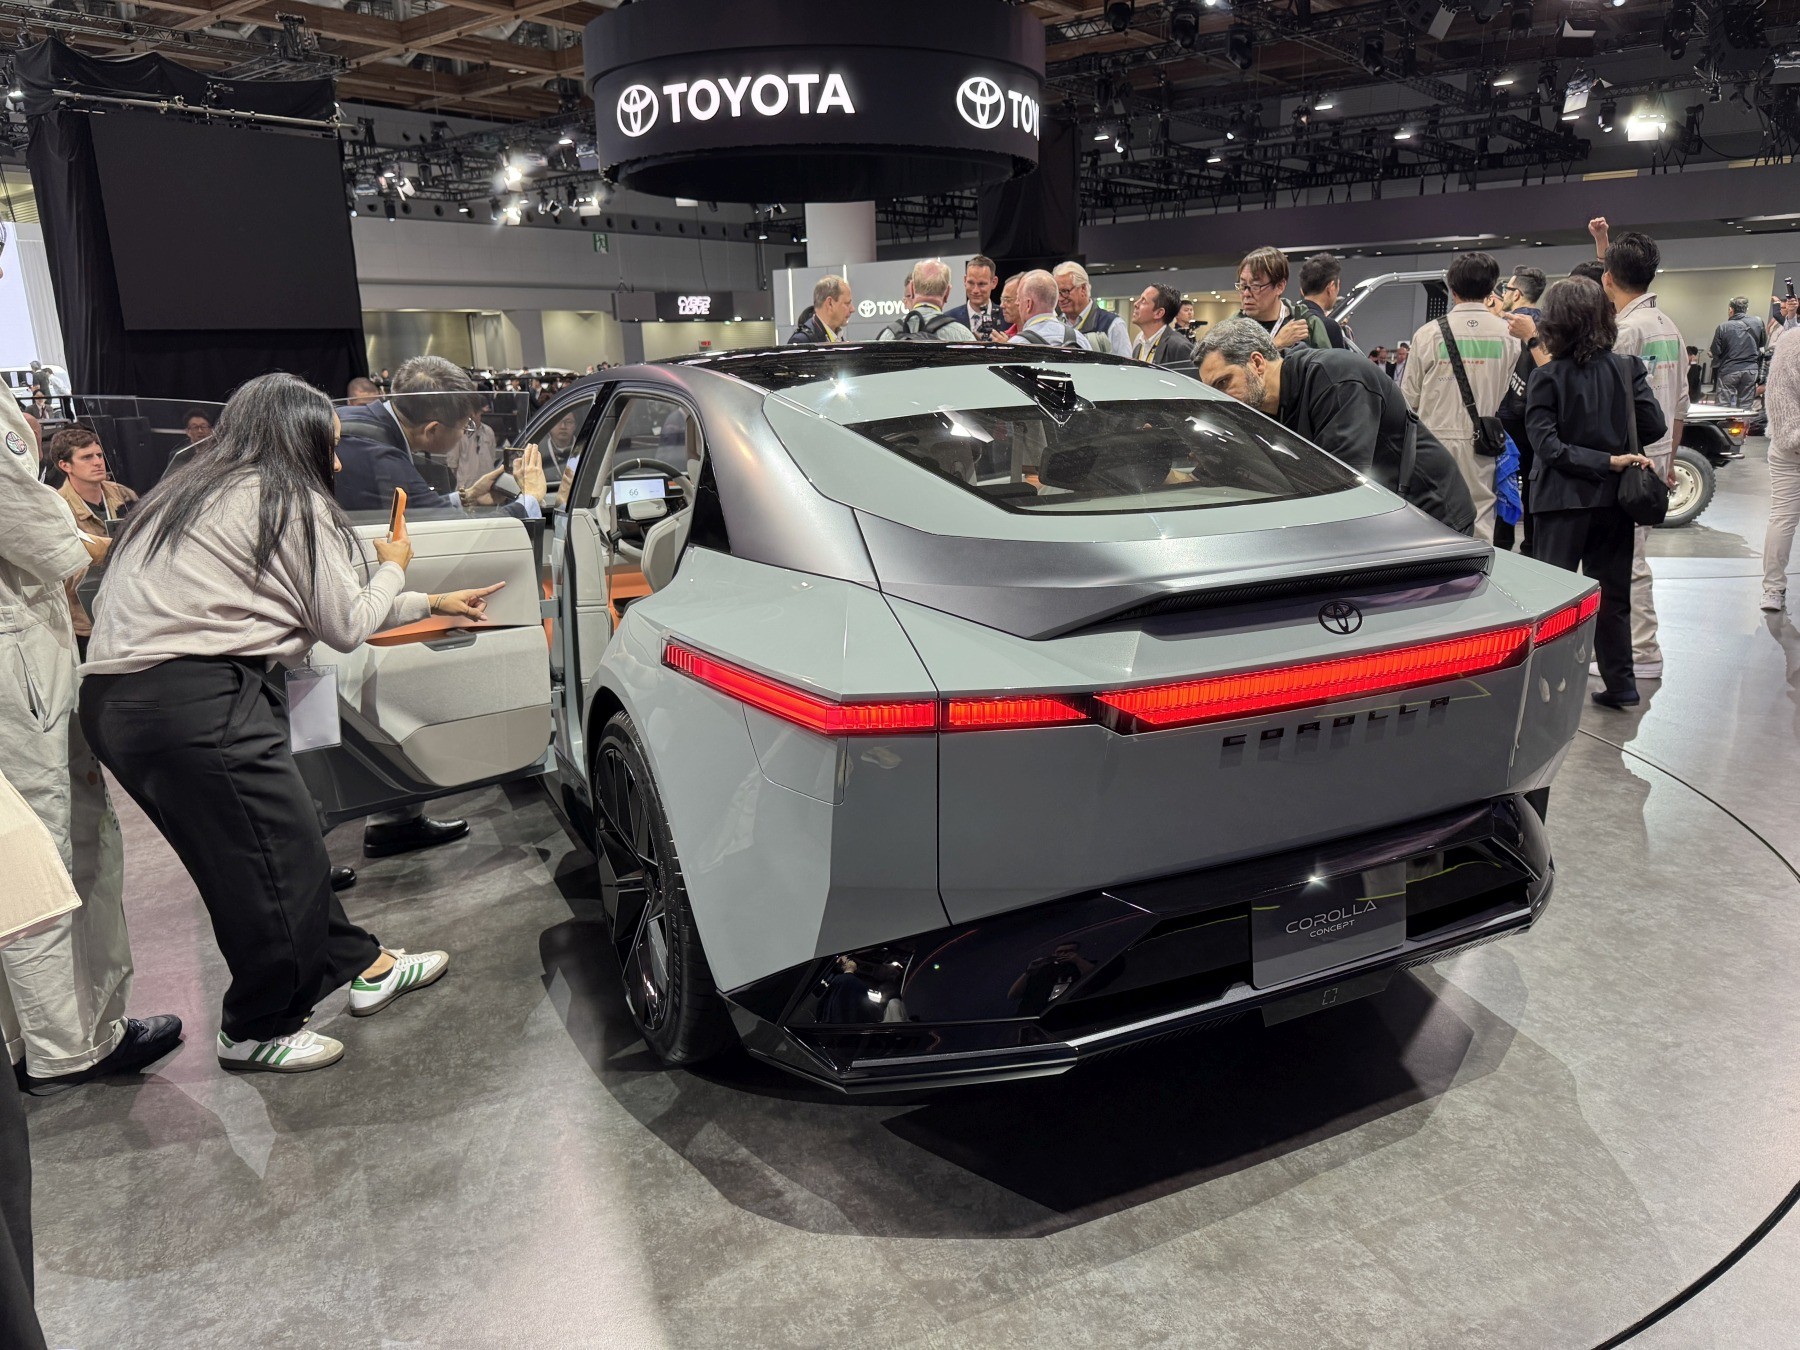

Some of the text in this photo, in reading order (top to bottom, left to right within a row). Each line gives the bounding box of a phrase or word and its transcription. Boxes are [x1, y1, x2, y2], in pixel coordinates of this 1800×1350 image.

[662, 73, 856, 123] TOYOTA
[677, 295, 711, 308] CYBER
[1222, 695, 1450, 748] COROLLA
[1285, 900, 1377, 934] COROLLA
[1309, 919, 1355, 938] CONCEPT
